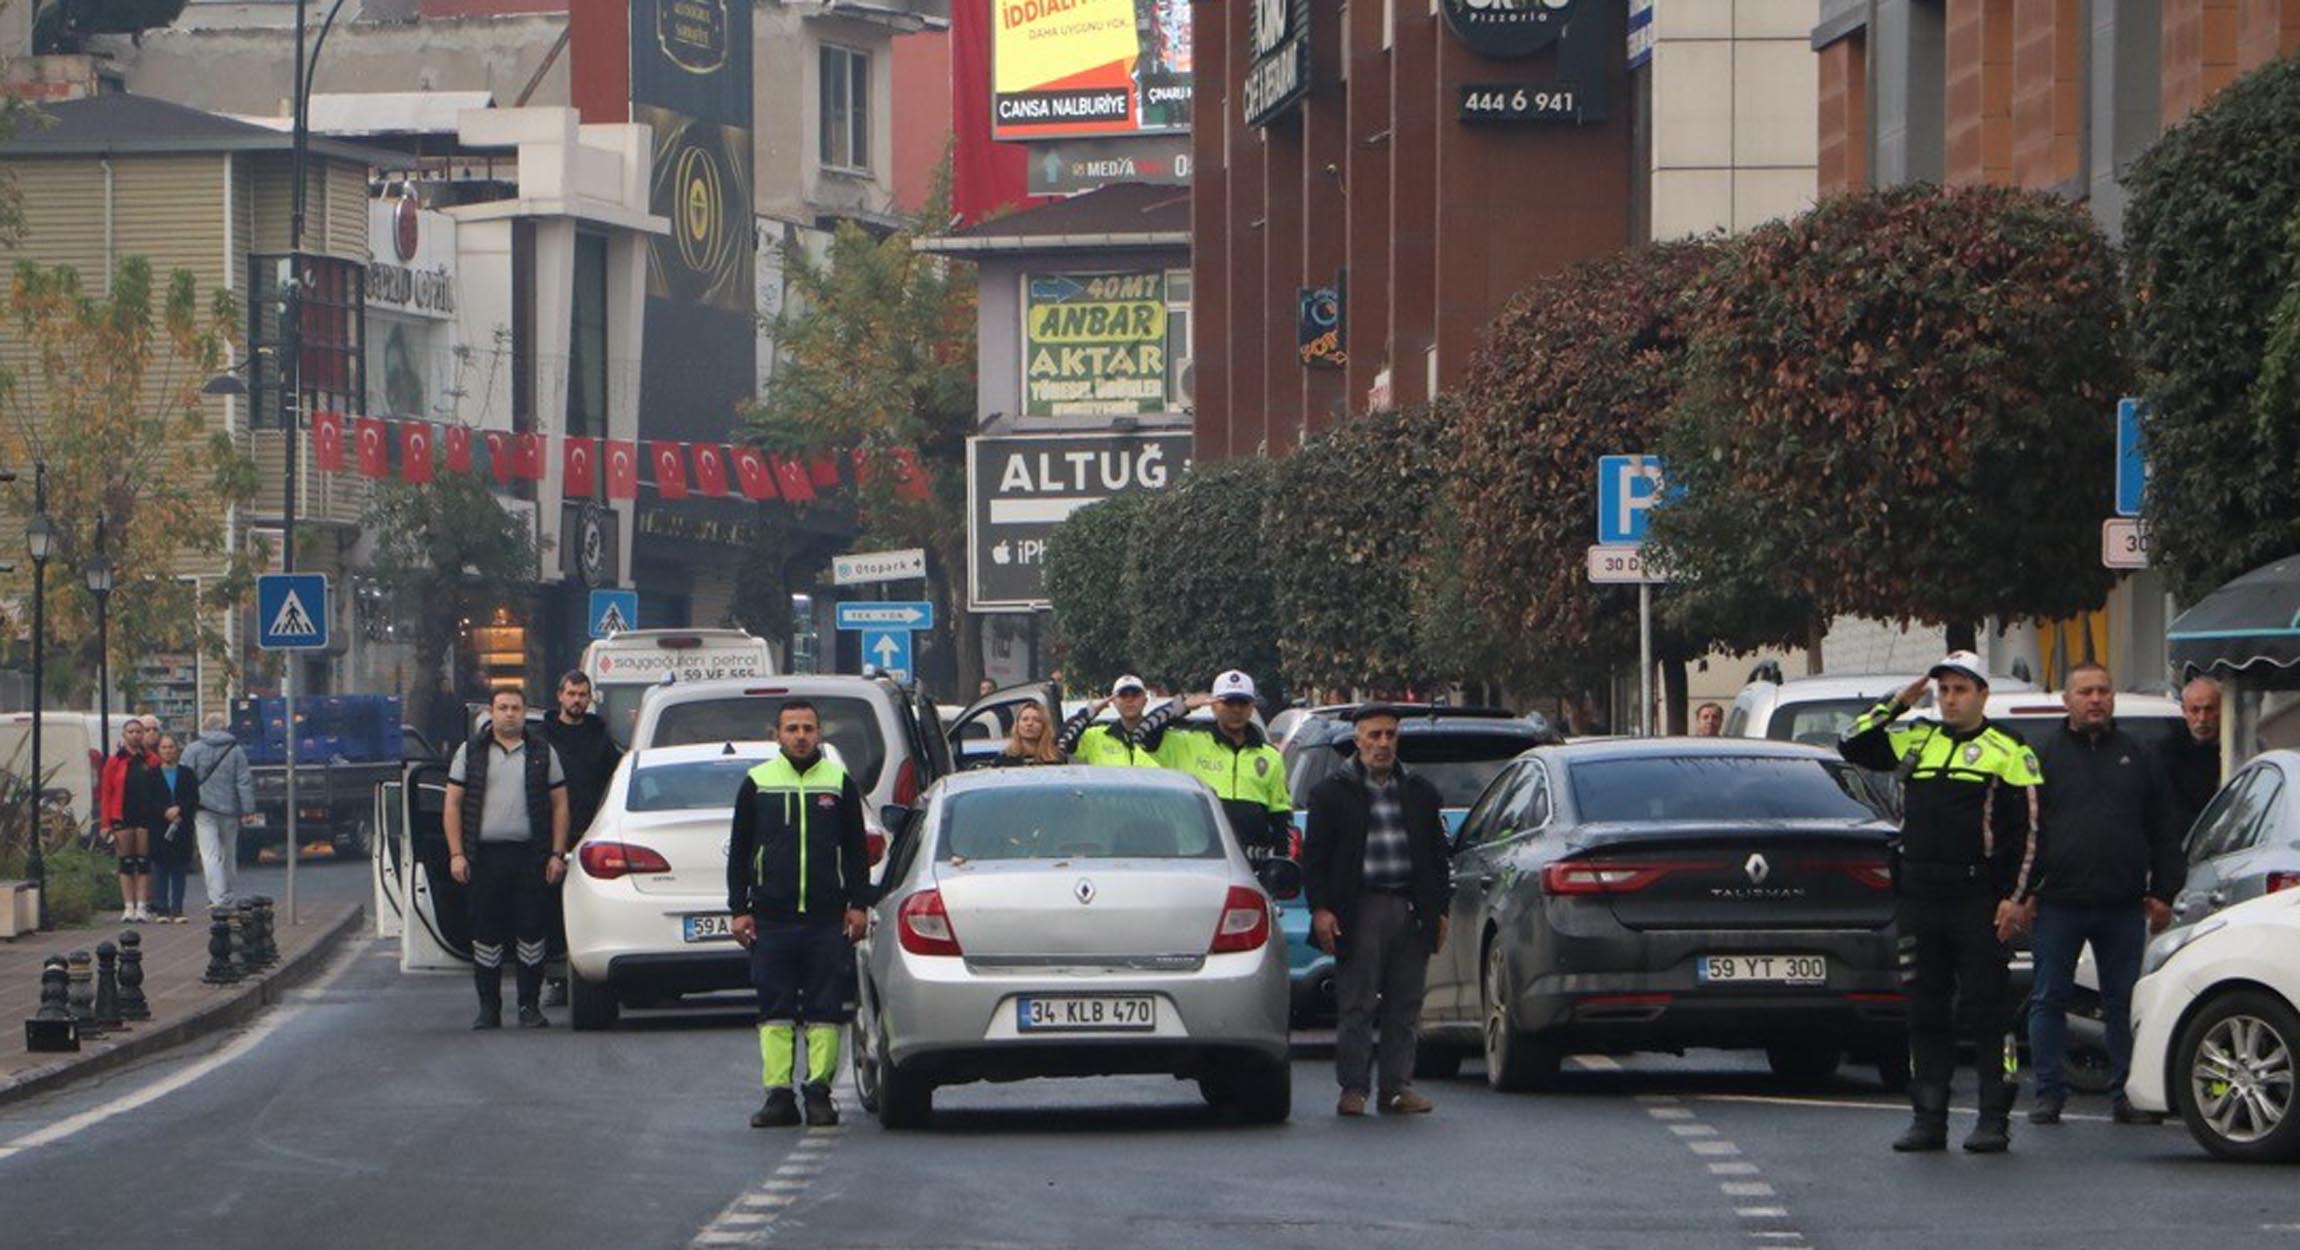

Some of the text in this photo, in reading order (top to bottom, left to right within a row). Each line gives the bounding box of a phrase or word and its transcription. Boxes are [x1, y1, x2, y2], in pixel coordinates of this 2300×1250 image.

[999, 93, 1126, 119] CANSA NALBURİYE
[1464, 89, 1573, 111] 444 6 941
[1086, 274, 1159, 299] 40MT
[1038, 304, 1155, 337] ANBAR
[1029, 344, 1163, 377] AKTAR
[999, 442, 1167, 492] ALTUĞ
[1619, 465, 1666, 535] P
[855, 561, 908, 575] Otopark
[1605, 557, 1623, 571] 30
[684, 668, 702, 681] 59
[695, 917, 714, 935] 59
[1709, 958, 1824, 977] 59 YT 300
[1032, 1002, 1149, 1022] 34 KLB 470
